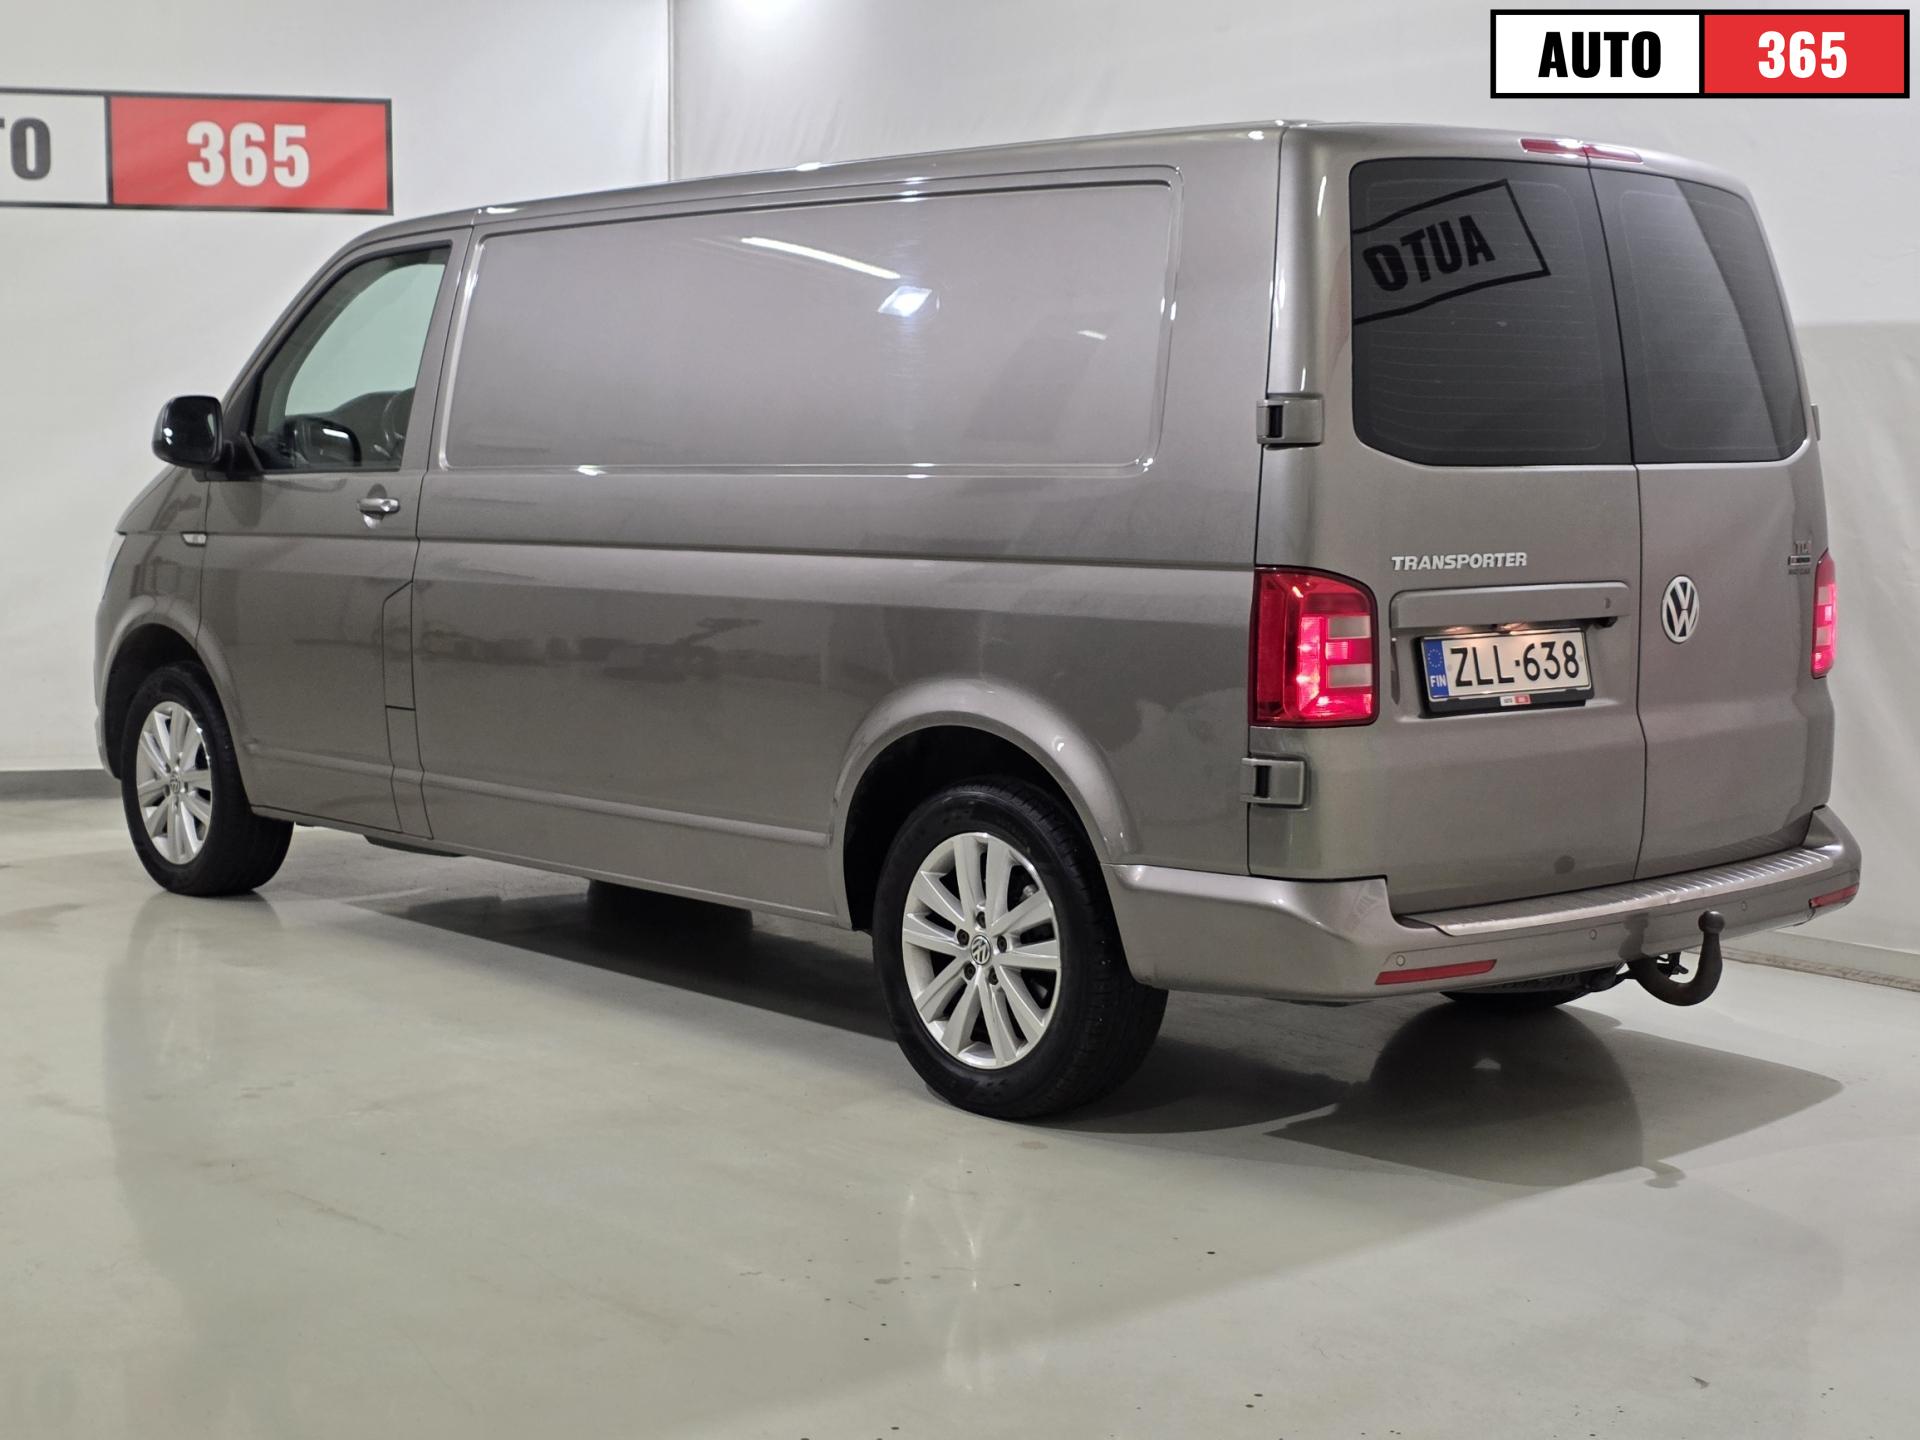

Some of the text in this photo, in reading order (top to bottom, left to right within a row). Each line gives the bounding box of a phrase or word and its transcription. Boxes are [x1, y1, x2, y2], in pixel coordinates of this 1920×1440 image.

[0, 117, 310, 188] O 365
[1391, 552, 1528, 571] TRANSPORTER
[1430, 675, 1447, 688] FIN
